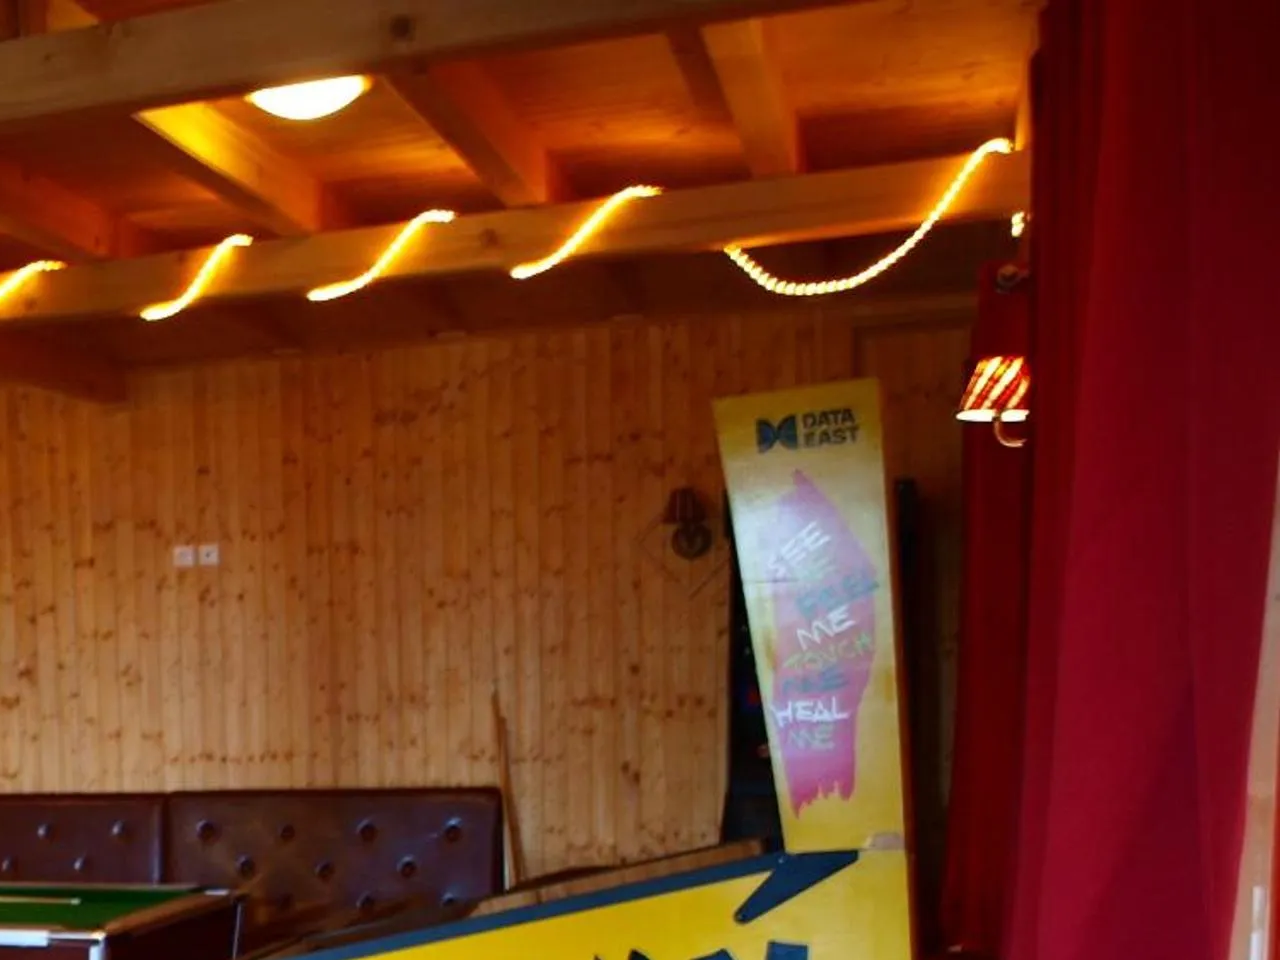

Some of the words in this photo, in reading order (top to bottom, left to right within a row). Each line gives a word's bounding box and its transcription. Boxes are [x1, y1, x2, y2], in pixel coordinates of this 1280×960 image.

[802, 408, 856, 429] DATA
[804, 425, 860, 448] EAST
[766, 520, 832, 579] SEE
[796, 604, 856, 651] ME
[782, 632, 875, 671] TOUCH
[770, 696, 852, 728] HEAL
[787, 722, 836, 751] ME
